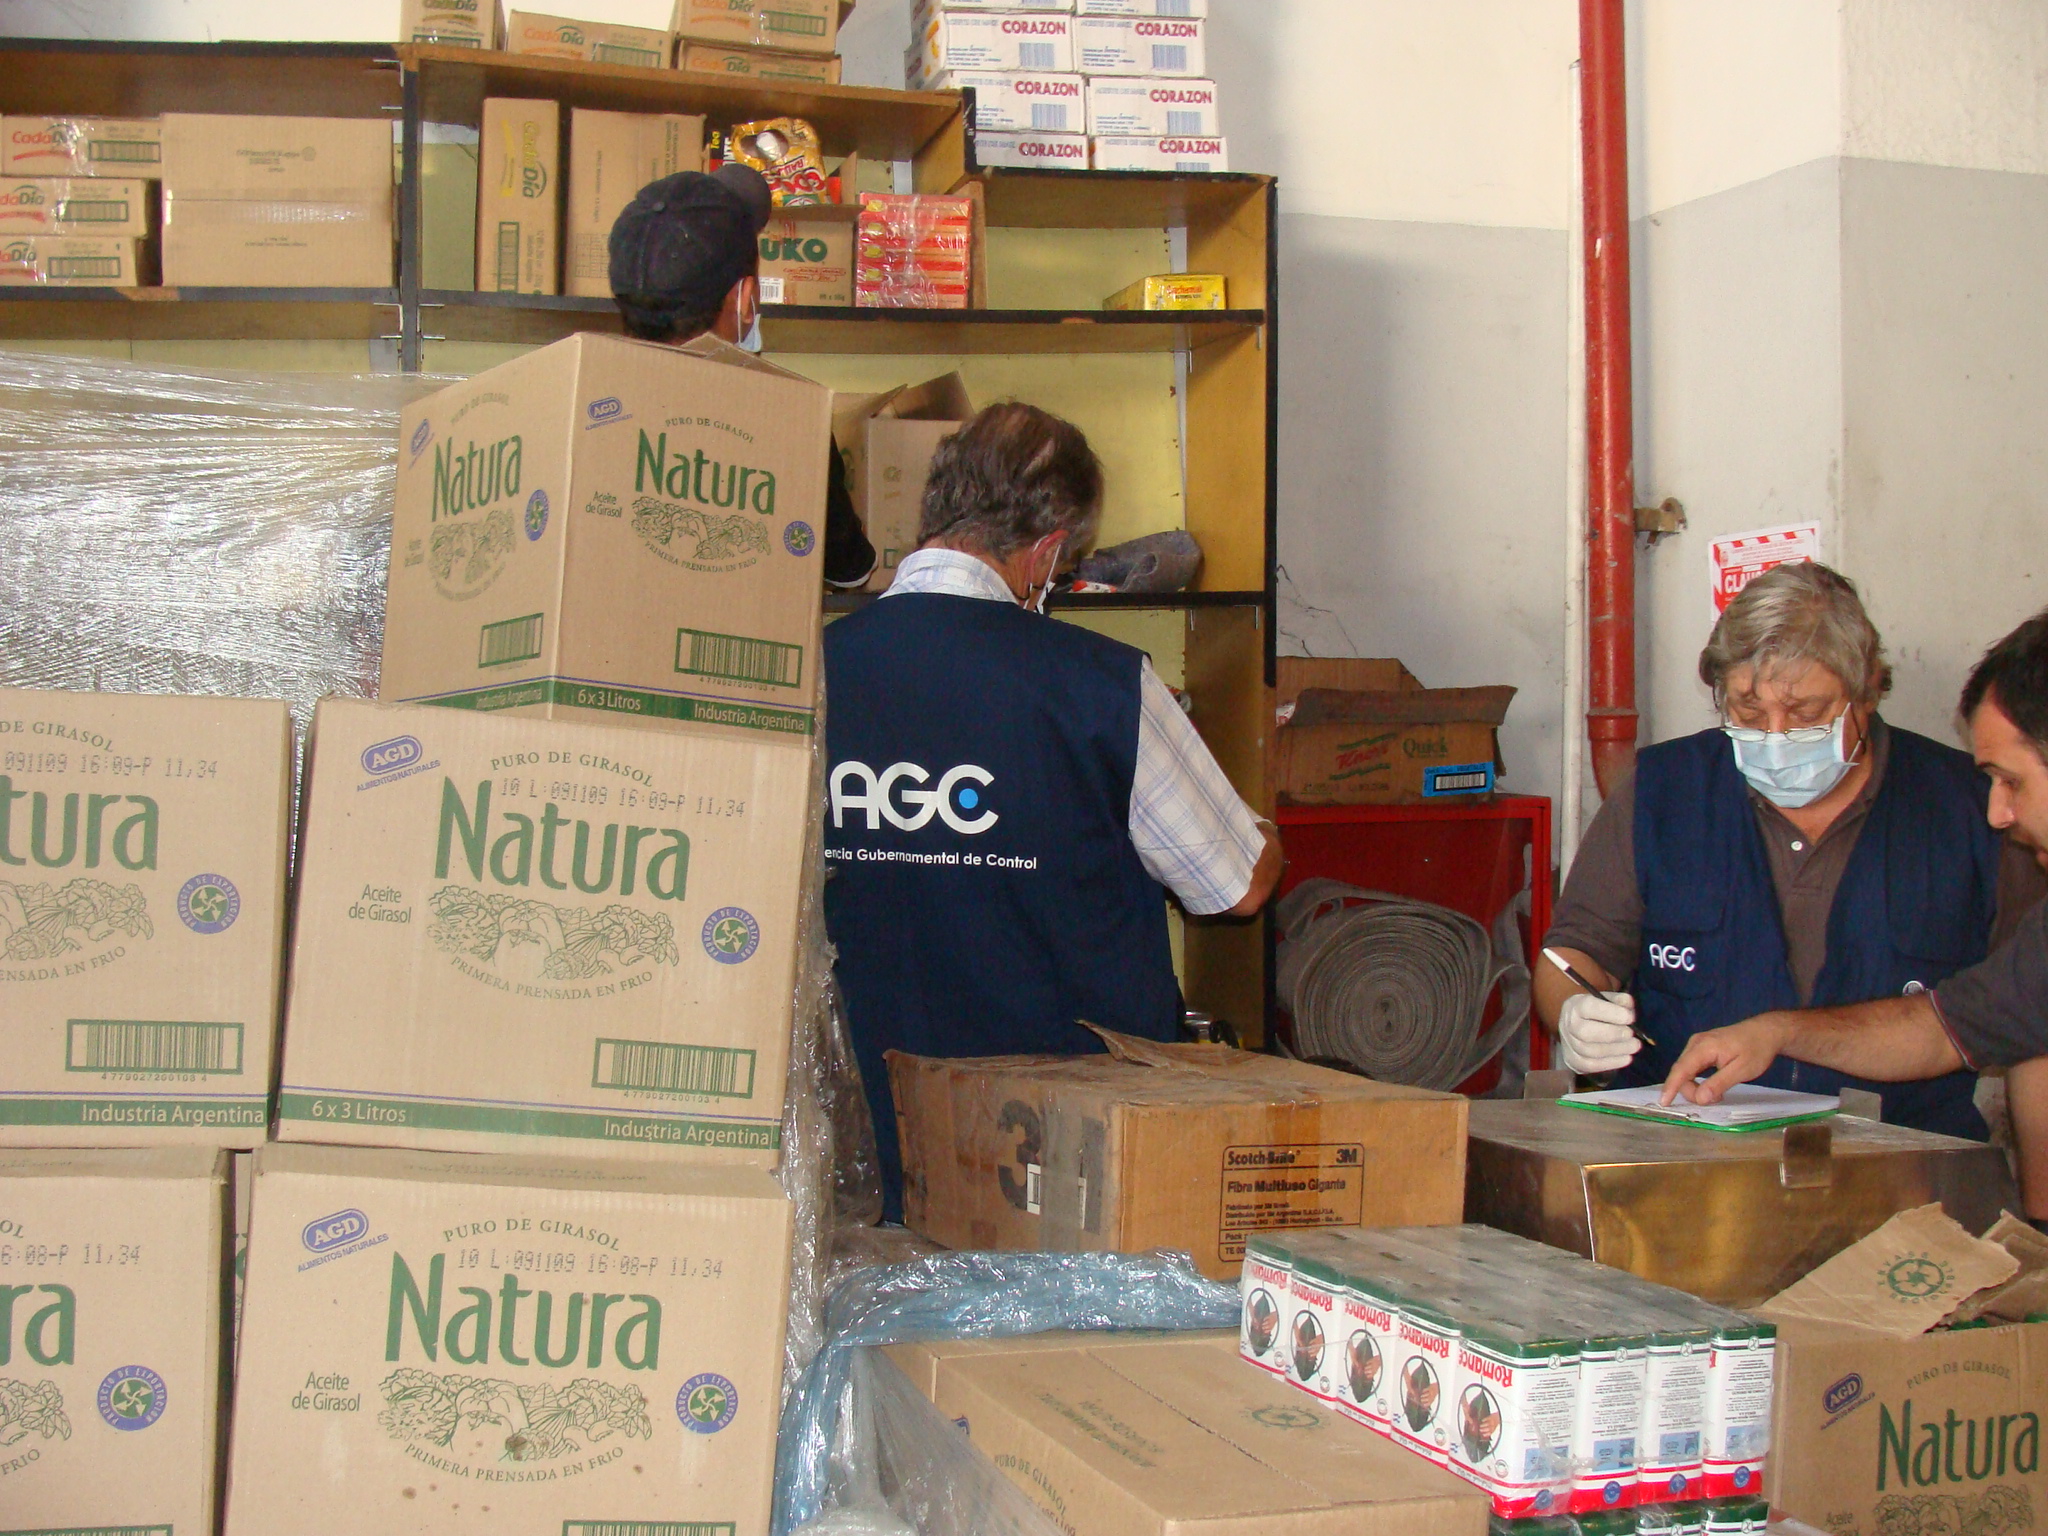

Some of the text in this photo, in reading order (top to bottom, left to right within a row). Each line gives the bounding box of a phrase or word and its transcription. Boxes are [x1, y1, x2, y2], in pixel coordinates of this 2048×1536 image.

[1001, 19, 1066, 35] CORAZON
[1134, 22, 1198, 37] CORAZON
[1014, 80, 1079, 96] CORAZON
[1149, 89, 1213, 103] CORAZON
[1018, 142, 1083, 157] CORAZON
[1159, 140, 1221, 154] CORAZON
[594, 401, 618, 417] AGD
[665, 416, 693, 428] PURO
[696, 417, 711, 427] DE
[431, 435, 523, 522] Natura
[634, 428, 777, 516] Natura
[585, 503, 623, 518] de Girasol
[592, 490, 617, 505] Aceite
[607, 691, 641, 711] Litros
[694, 703, 805, 730] Industria Argentina
[0, 721, 114, 752] DE GIRASOL
[1402, 737, 1448, 758] Quick
[371, 743, 415, 768] AGD
[356, 760, 441, 792] ALIMENTOS NATURALES
[490, 751, 654, 788] PURO DE GIRASOL
[829, 760, 999, 835] AGC
[434, 776, 691, 902] Natura
[856, 848, 960, 865] Gubernamental
[963, 852, 982, 866] de
[986, 853, 1037, 870] Control
[361, 884, 402, 904] Aceite
[348, 904, 412, 924] de Girasol
[65, 961, 86, 977] EN
[91, 946, 127, 969] FRIO
[1649, 943, 1696, 972] AGC
[450, 956, 653, 1000] PRIMERA PRENSADA EN FRIO
[82, 1104, 264, 1125] Industria Argentina
[312, 1101, 323, 1118] 6
[341, 1103, 351, 1119] 3
[355, 1103, 406, 1122] Litros
[604, 1119, 771, 1147] Industria Argentina
[1335, 1148, 1358, 1164] 3M
[1227, 1178, 1346, 1194] Fibra Multiuso Gigante
[313, 1216, 361, 1248] AGD
[443, 1218, 621, 1251] PURO DE GIRASOL
[297, 1233, 389, 1273] ALIMENTOS NATURALES
[385, 1251, 663, 1371] Natura
[1344, 1299, 1392, 1333] Romance
[1398, 1319, 1450, 1359] Romance
[118, 1367, 131, 1378] DE
[304, 1371, 350, 1391] Aceite
[1458, 1347, 1513, 1388] Romance
[1906, 1360, 2012, 1389] PURO DE GIRASOL
[291, 1391, 361, 1412] de Girasol
[1829, 1375, 1860, 1408] AGD
[1876, 1398, 2040, 1492] Natura
[1, 1448, 41, 1476] FRIO
[404, 1442, 625, 1483] PRIMERA PRENSADA EN FRIO
